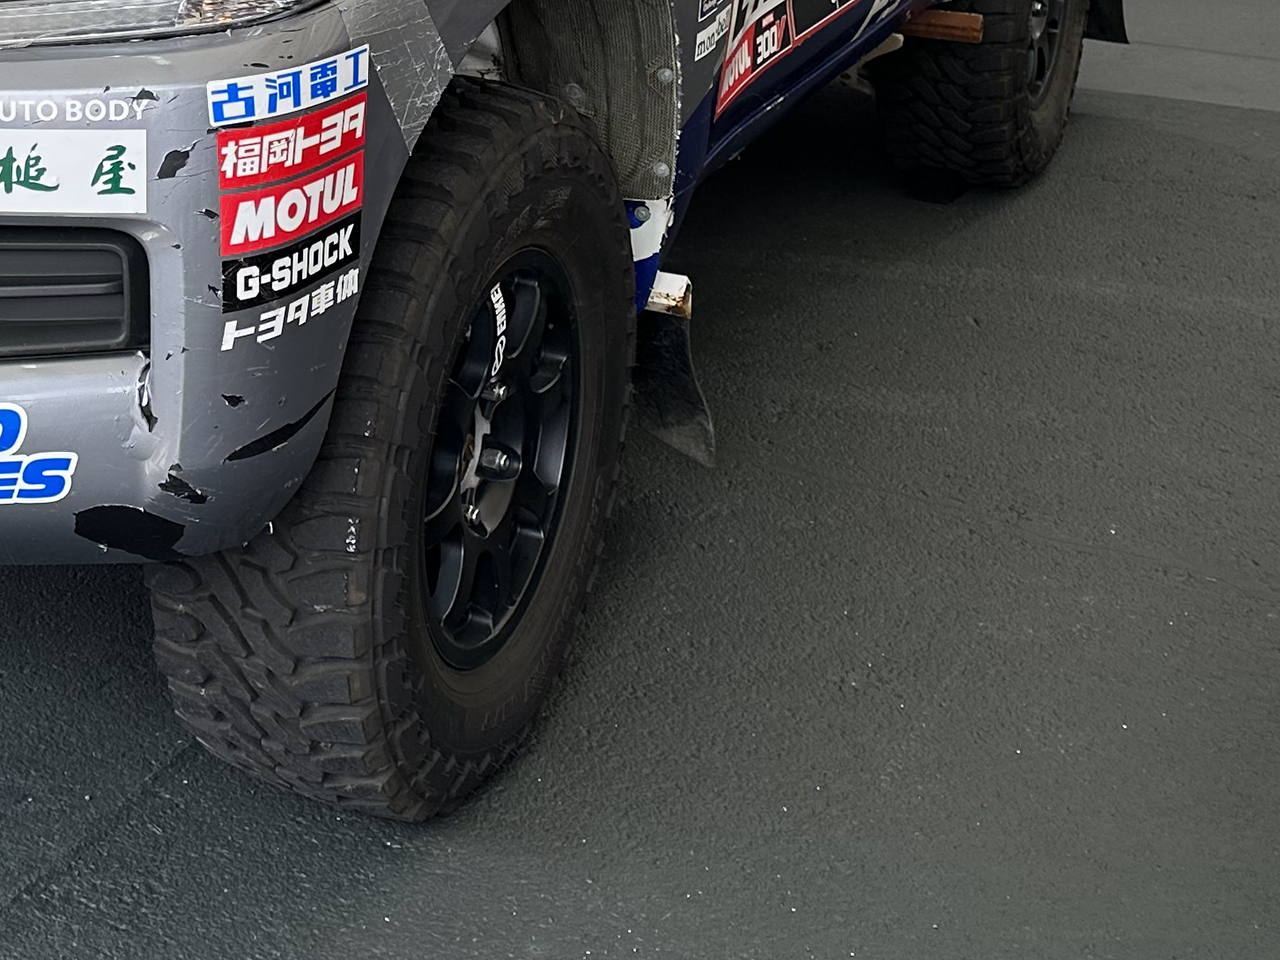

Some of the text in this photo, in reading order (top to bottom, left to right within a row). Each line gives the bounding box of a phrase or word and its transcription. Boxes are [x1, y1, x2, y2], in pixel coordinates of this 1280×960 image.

[756, 14, 788, 65] 300V
[65, 100, 147, 122] BODY
[211, 48, 367, 123] 古河電工
[220, 101, 366, 178] 福岡トヨタ
[229, 162, 358, 246] MOTUL
[236, 222, 355, 301] G-SHOCK
[220, 267, 360, 352] トヨタ車体
